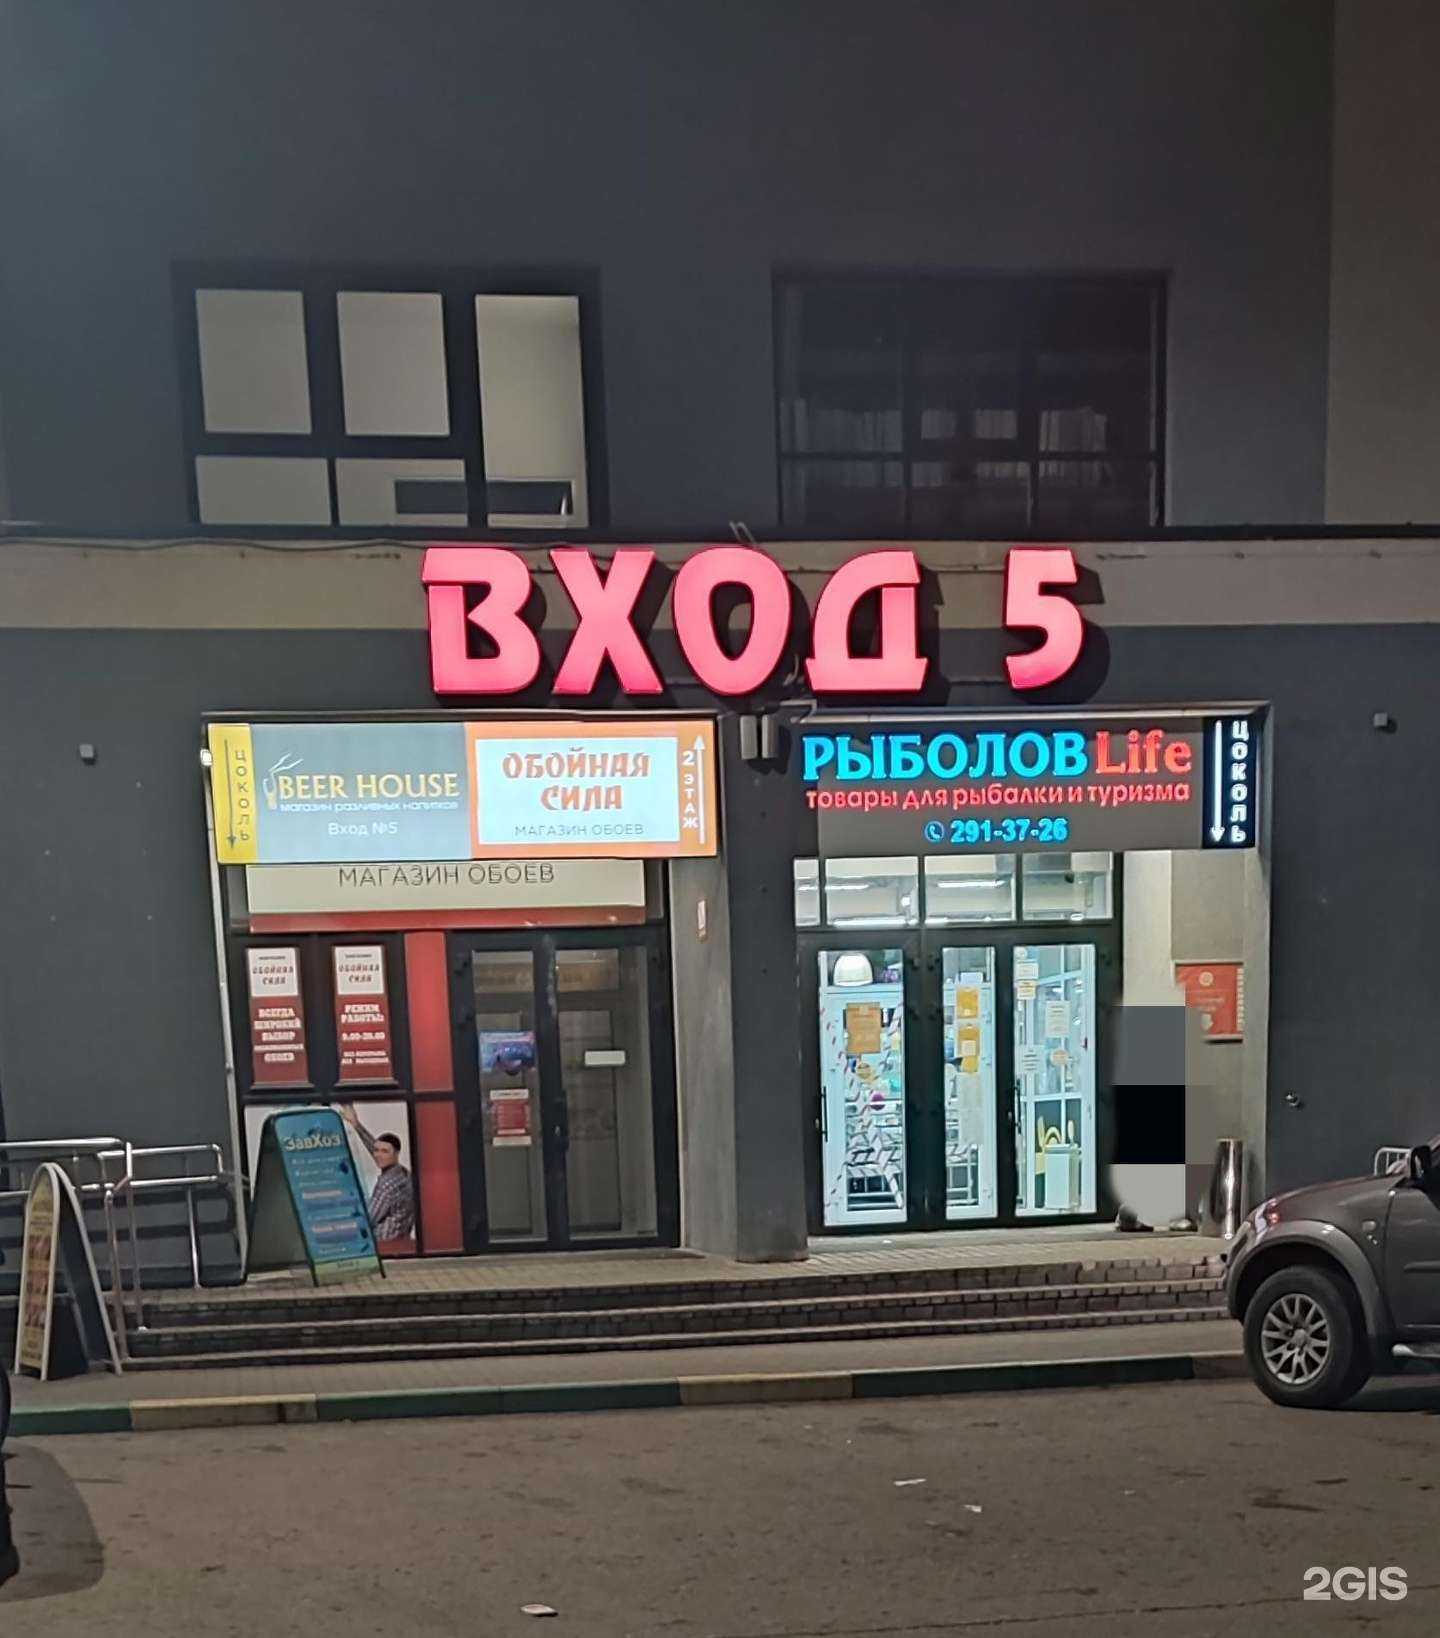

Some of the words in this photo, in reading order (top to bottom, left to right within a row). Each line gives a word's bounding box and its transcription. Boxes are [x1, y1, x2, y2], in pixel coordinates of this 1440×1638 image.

[422, 547, 928, 694] ВХОД
[1004, 549, 1084, 690] 5
[502, 746, 649, 779] ОБОЙНАЯ
[682, 750, 696, 766] 2
[278, 775, 349, 801] BEER
[355, 773, 460, 799] HOUSE
[541, 784, 623, 812] СИЛА
[682, 773, 699, 829] ЭТАЖ
[806, 789, 898, 812] товары
[902, 788, 948, 810] для
[952, 782, 1063, 811] рыбалки
[1068, 785, 1082, 802] и
[1087, 782, 1190, 807] туризма
[328, 822, 370, 836] Вход
[515, 824, 588, 837] МАГАЗИН
[591, 823, 645, 836] ОБОЕВ
[950, 818, 1069, 844] 291-37-26
[338, 865, 460, 888] МАГАЗИН
[467, 863, 556, 885] ОБОЕВ
